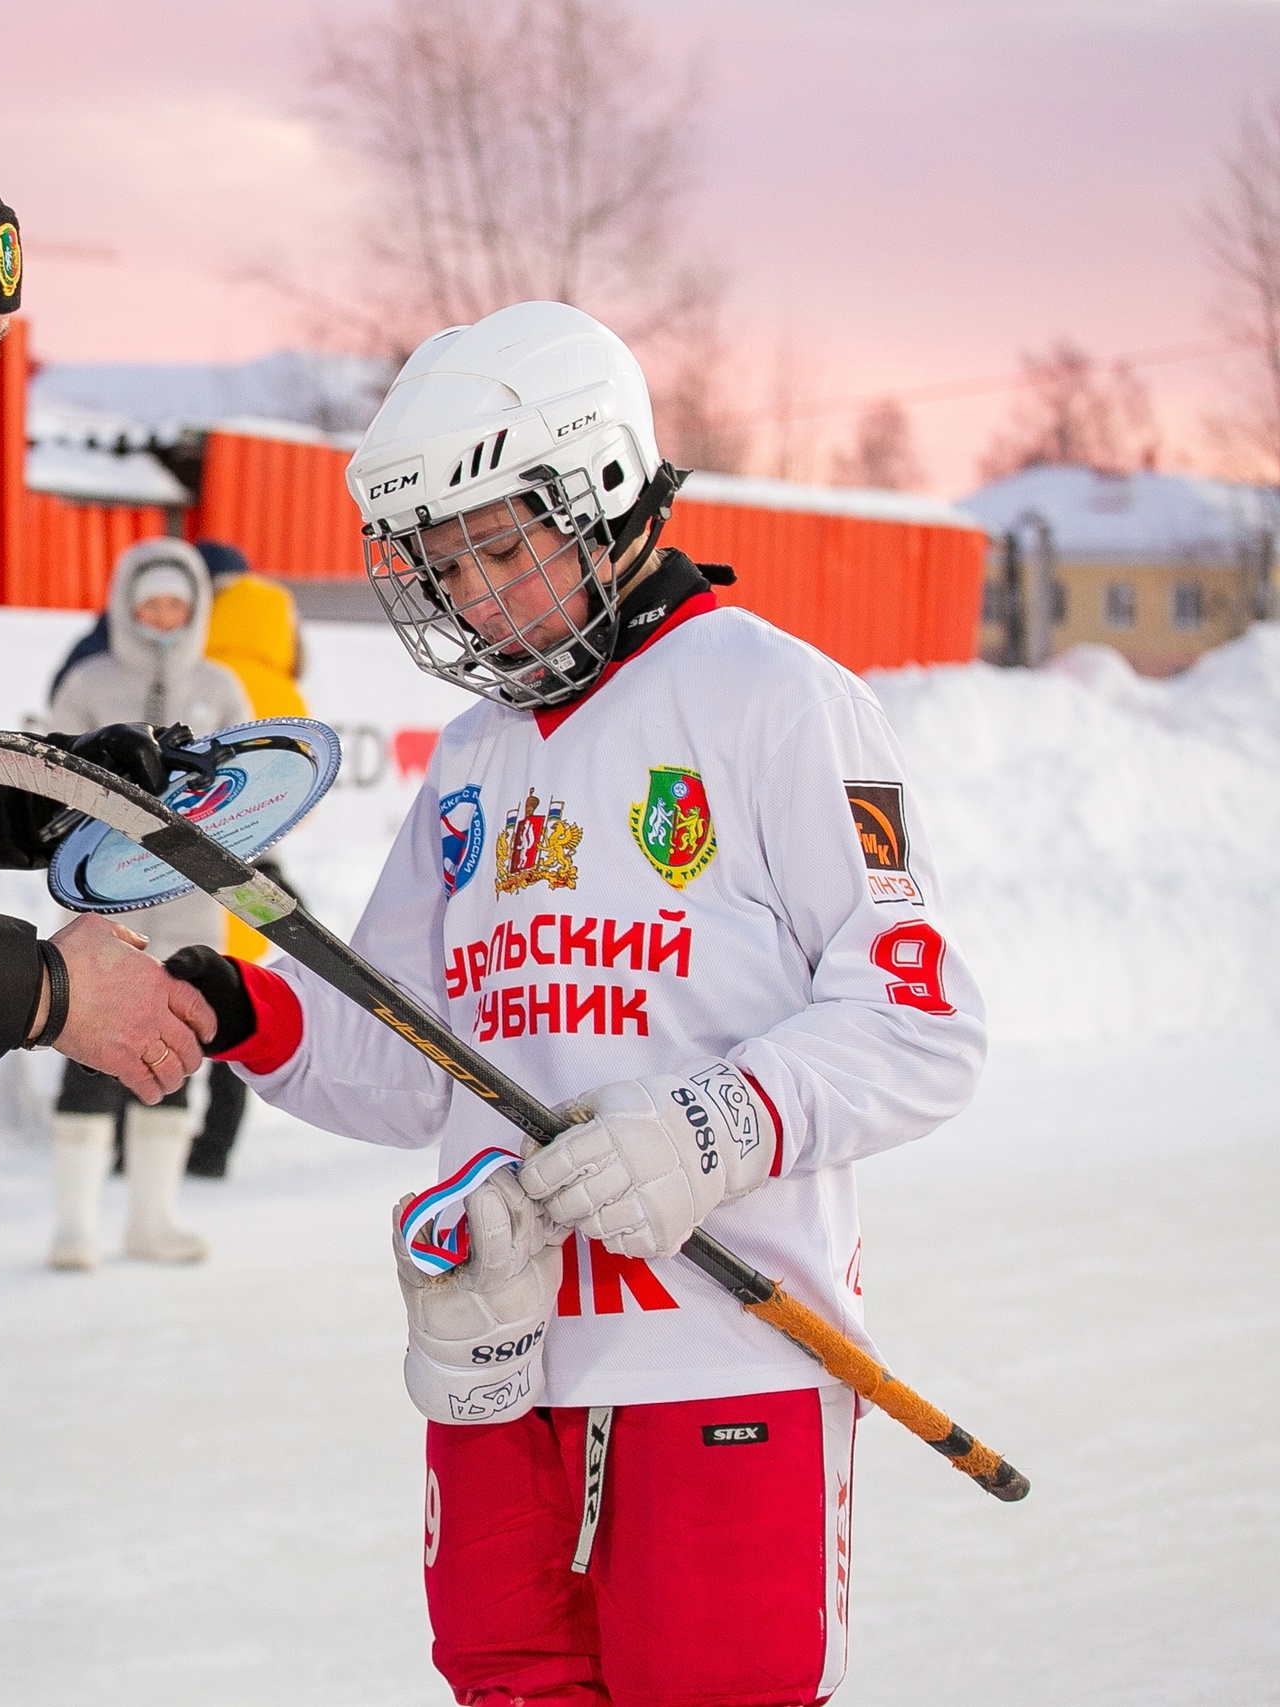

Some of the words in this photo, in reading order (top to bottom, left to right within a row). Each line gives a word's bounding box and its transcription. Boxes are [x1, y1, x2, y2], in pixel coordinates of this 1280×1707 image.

[556, 412, 597, 438] CCM
[370, 471, 419, 500] CCM
[628, 605, 667, 628] STEX
[464, 820, 482, 873] РОССИИ
[868, 875, 915, 897] ПНТЗ
[445, 909, 692, 999] УРАЛЬСКИЙ
[868, 919, 958, 1016] 9
[473, 982, 649, 1043] УБНИК
[368, 992, 499, 1099] COBRA
[671, 1088, 718, 1174] 8088
[471, 1321, 545, 1364] 8088
[713, 1427, 758, 1440] STEX
